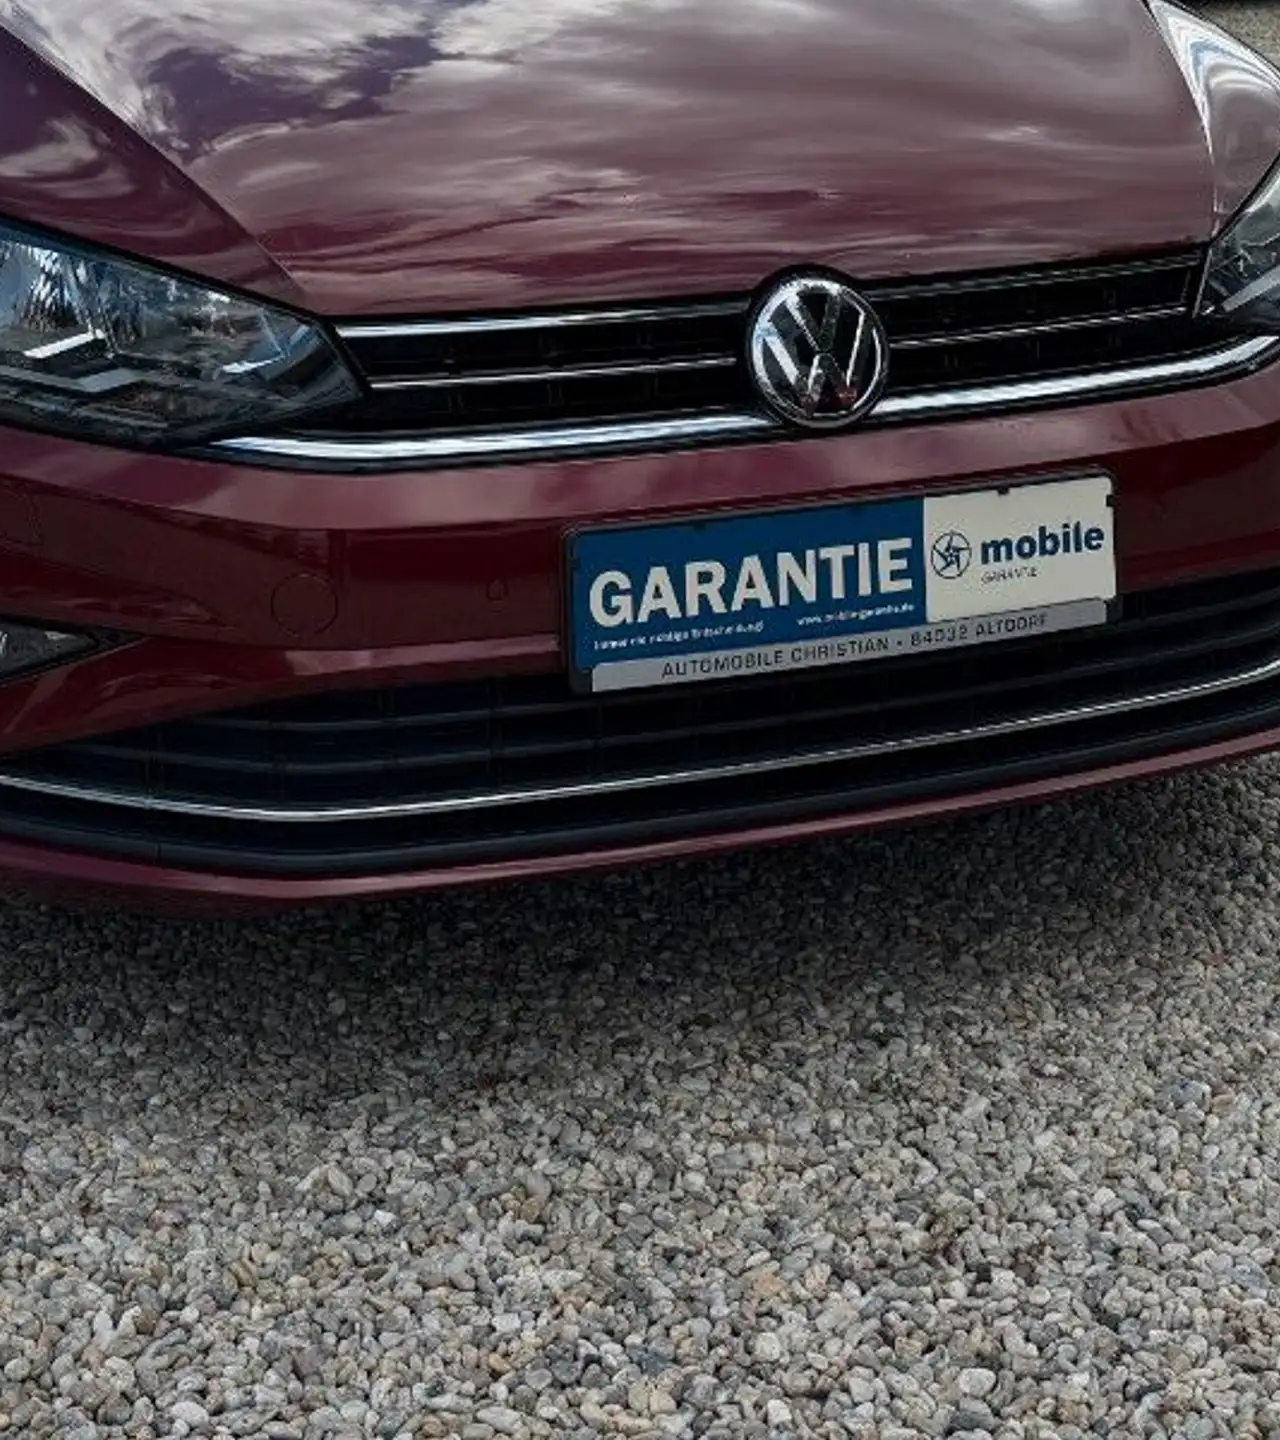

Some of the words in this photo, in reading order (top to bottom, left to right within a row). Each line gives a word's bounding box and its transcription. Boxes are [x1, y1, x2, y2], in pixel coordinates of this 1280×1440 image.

[981, 521, 1105, 565] mobile
[589, 538, 913, 627] GARANTIE
[661, 650, 783, 678] AUTOMOBILE
[791, 637, 888, 662] CHRISTIAN
